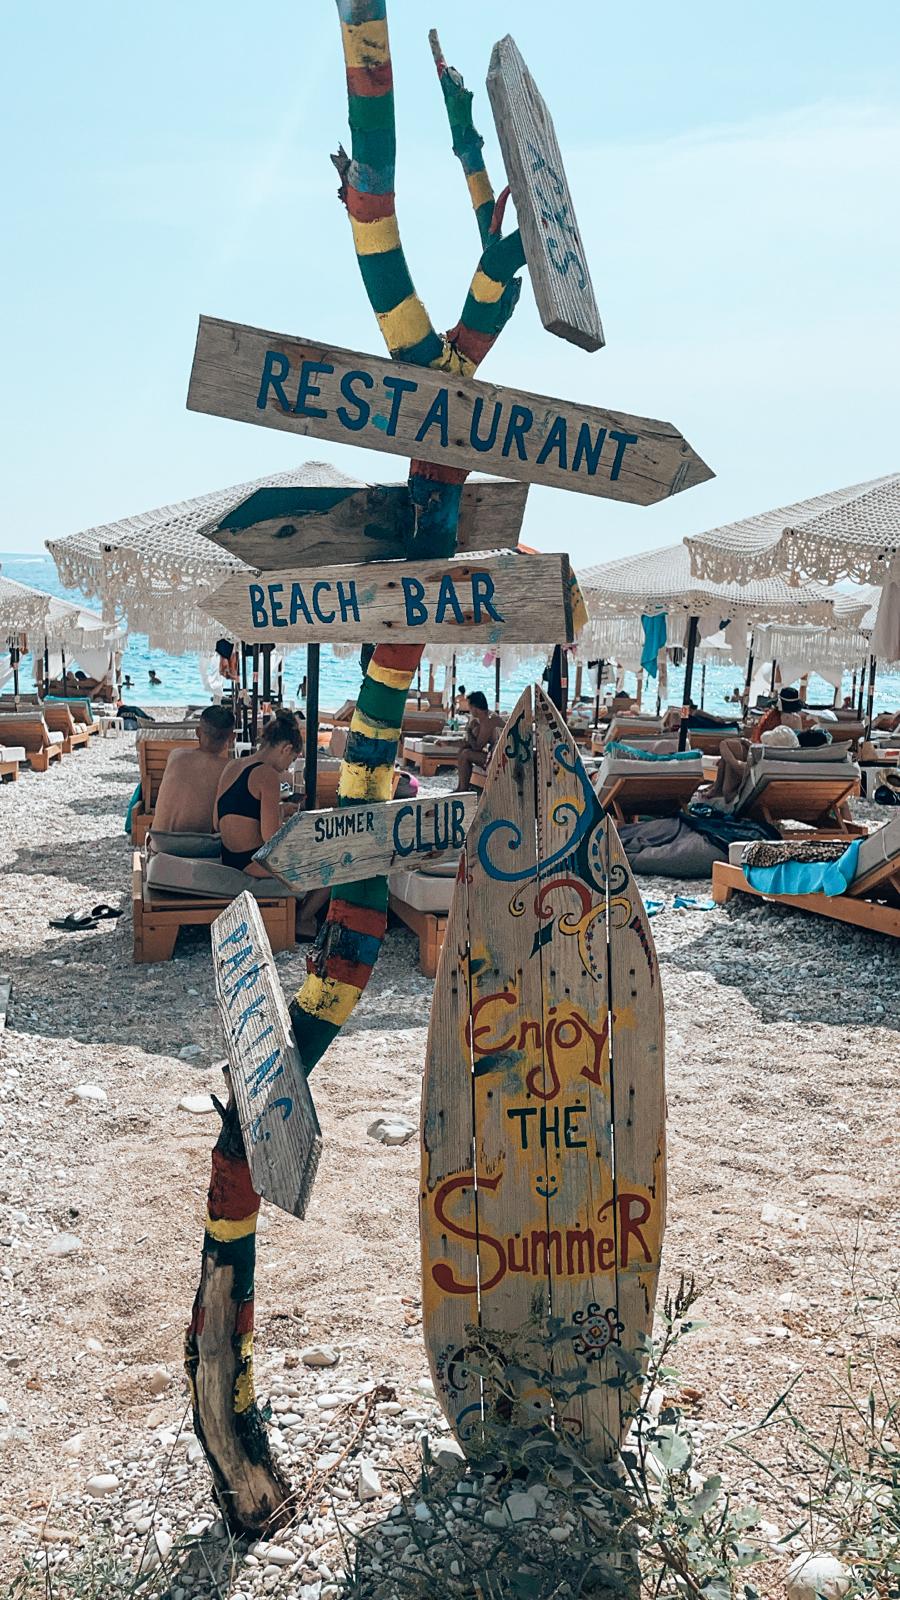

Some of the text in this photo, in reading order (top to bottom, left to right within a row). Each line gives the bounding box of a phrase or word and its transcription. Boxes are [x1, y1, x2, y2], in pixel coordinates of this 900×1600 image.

[256, 350, 638, 481] RESTAURANT
[249, 573, 506, 628] BEACH BAR
[315, 801, 465, 857] SUMMER CLUB
[218, 922, 292, 1144] PARKING
[465, 992, 617, 1100] Enjoy
[507, 1106, 587, 1148] THE
